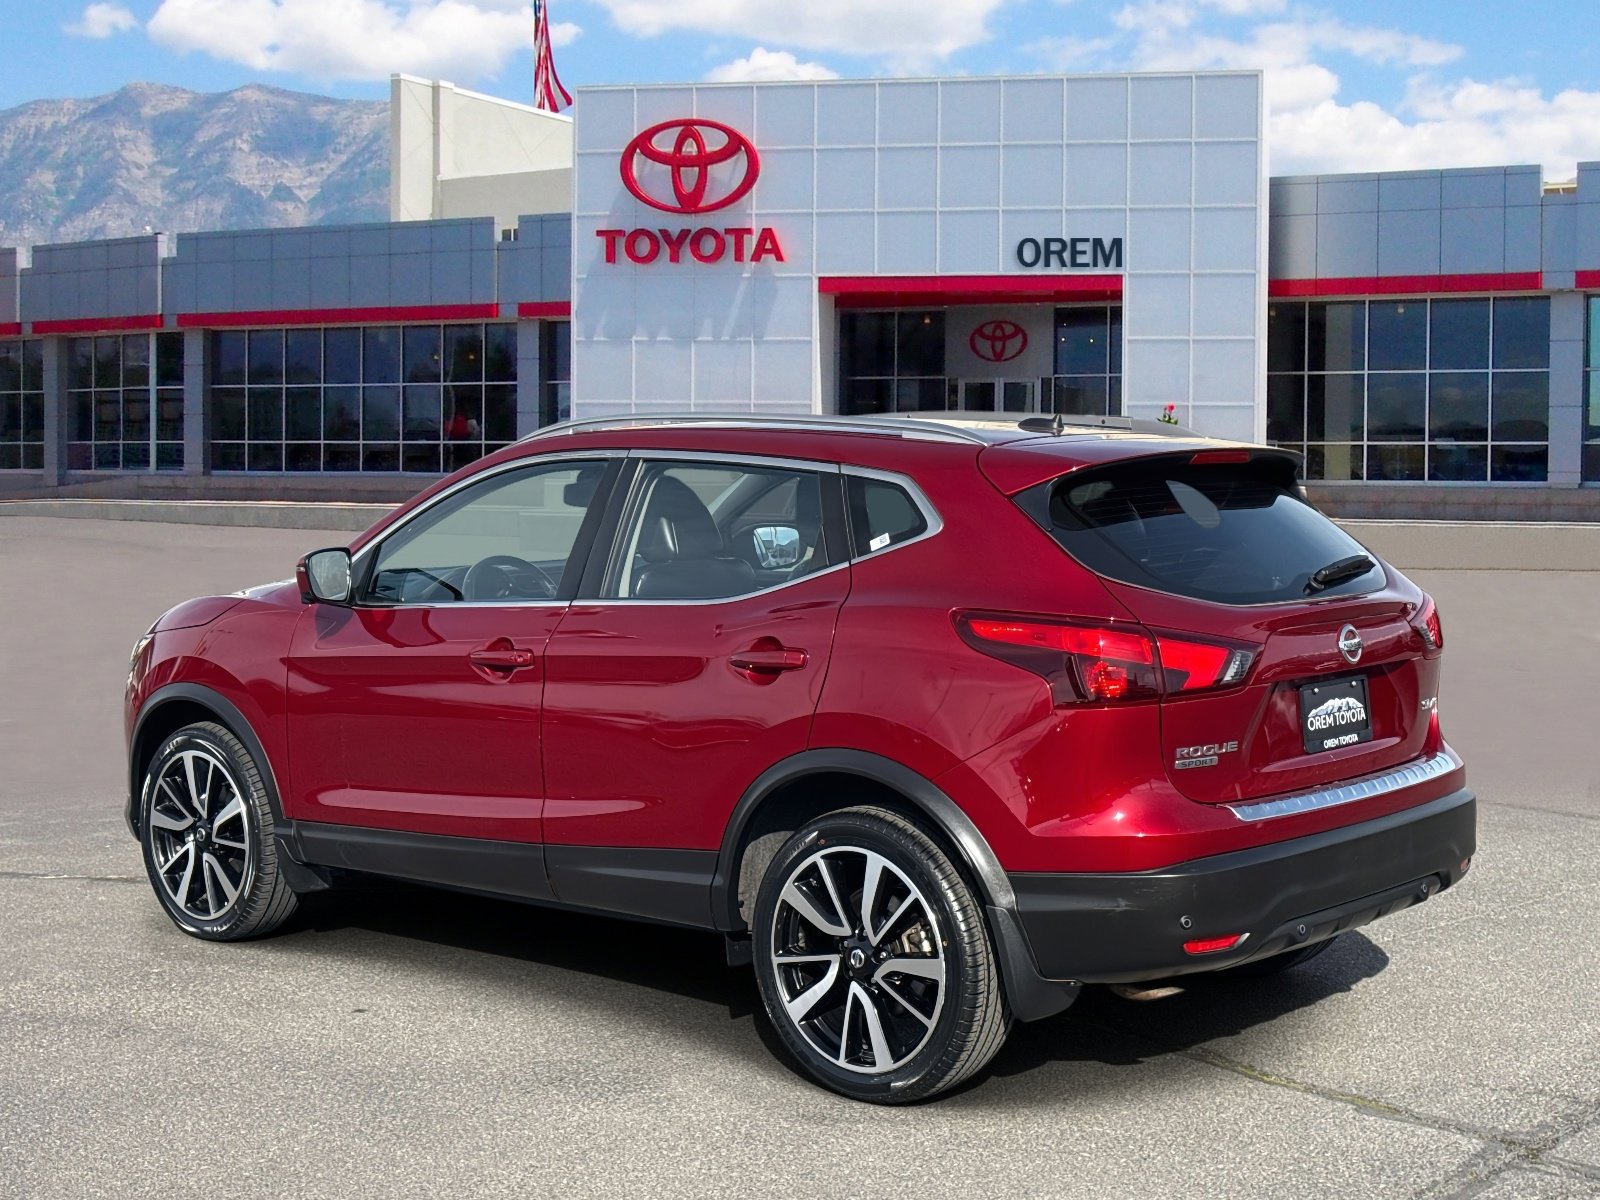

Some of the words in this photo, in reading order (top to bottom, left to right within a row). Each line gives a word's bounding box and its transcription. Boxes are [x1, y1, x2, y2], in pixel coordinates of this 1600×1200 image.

[596, 227, 784, 264] TOYOTA
[1017, 237, 1122, 267] OREM
[1307, 713, 1335, 731] OREM
[1334, 707, 1366, 725] TOYOTA
[1176, 741, 1239, 758] ROGUE
[1323, 737, 1339, 749] OREM
[1338, 733, 1359, 745] TOYOTA
[1181, 758, 1214, 768] SPORT
